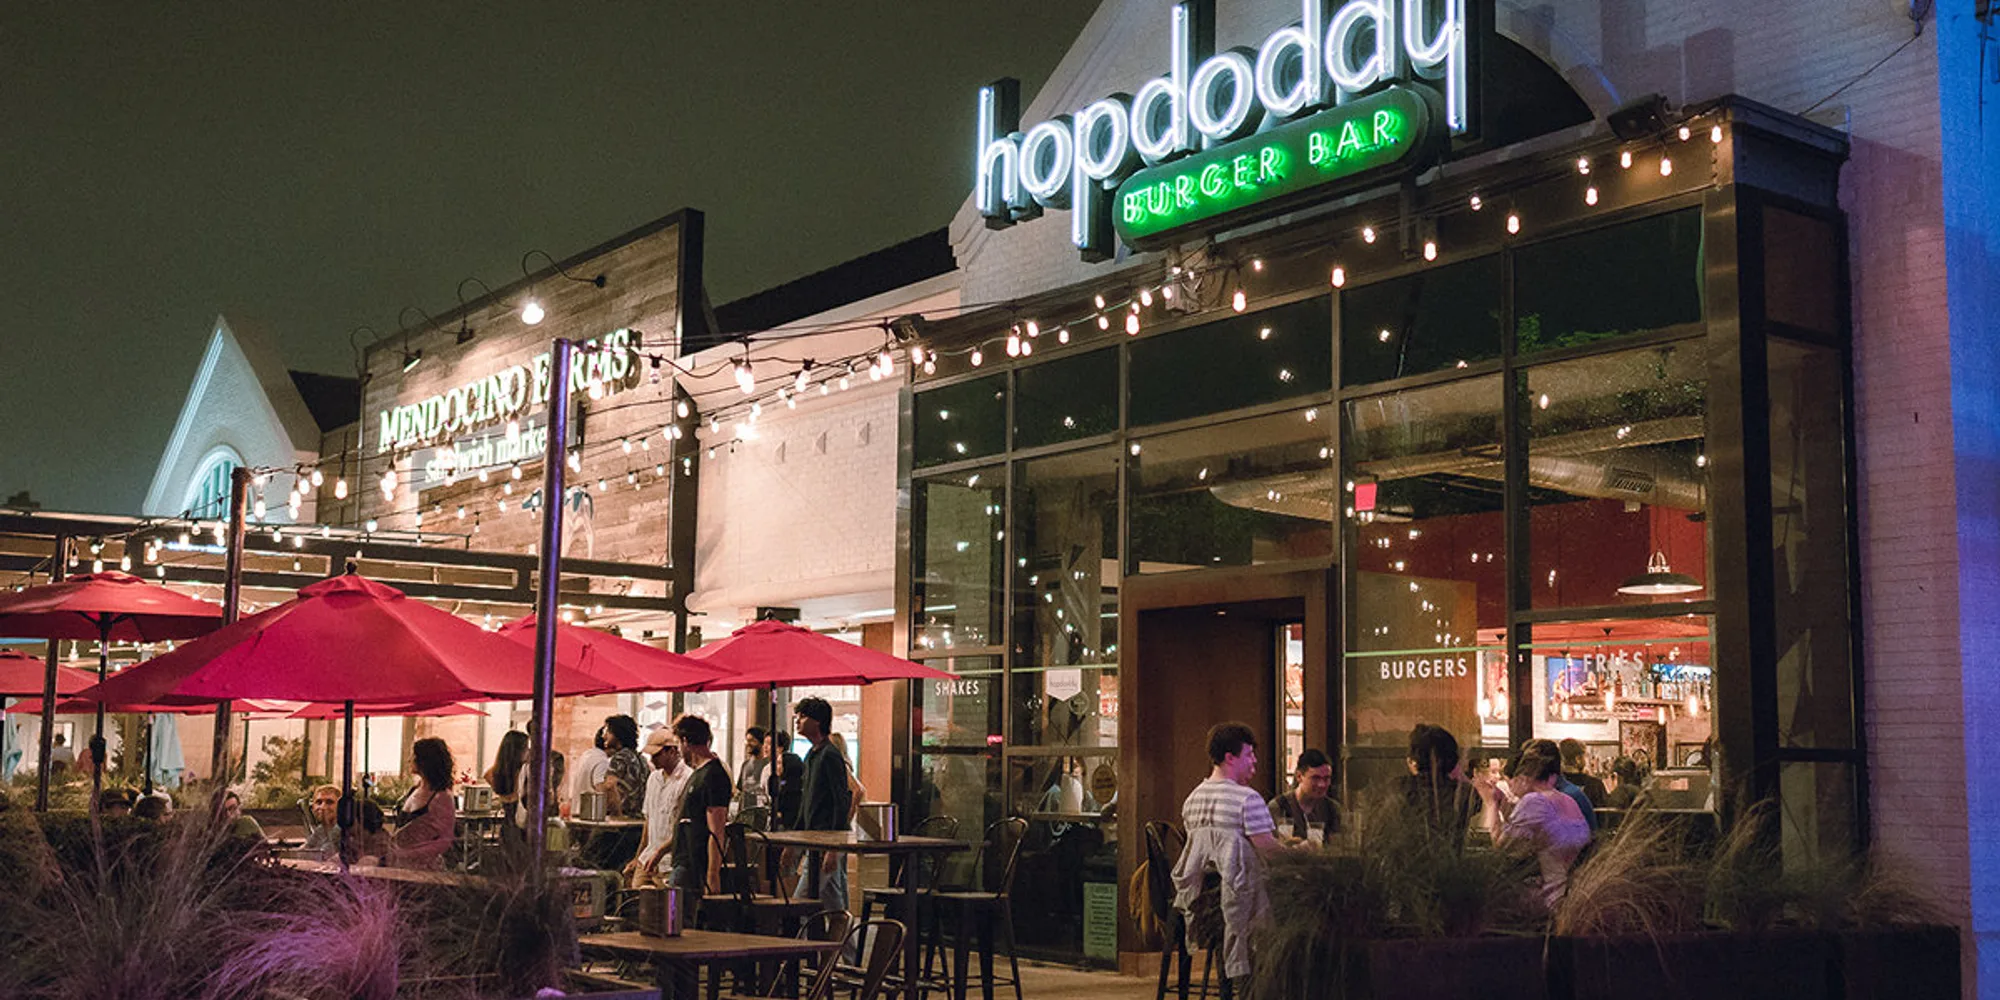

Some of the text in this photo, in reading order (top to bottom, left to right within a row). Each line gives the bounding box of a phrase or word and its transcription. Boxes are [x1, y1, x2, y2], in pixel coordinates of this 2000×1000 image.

[976, 0, 1468, 248] hopdoddy
[1123, 110, 1396, 223] BURGER BAR
[378, 328, 630, 454] MENDOCINO FRMS
[496, 420, 548, 461] marke
[1380, 657, 1468, 679] BURGERS
[1583, 651, 1644, 673] FRIES
[935, 680, 980, 696] SHAKES
